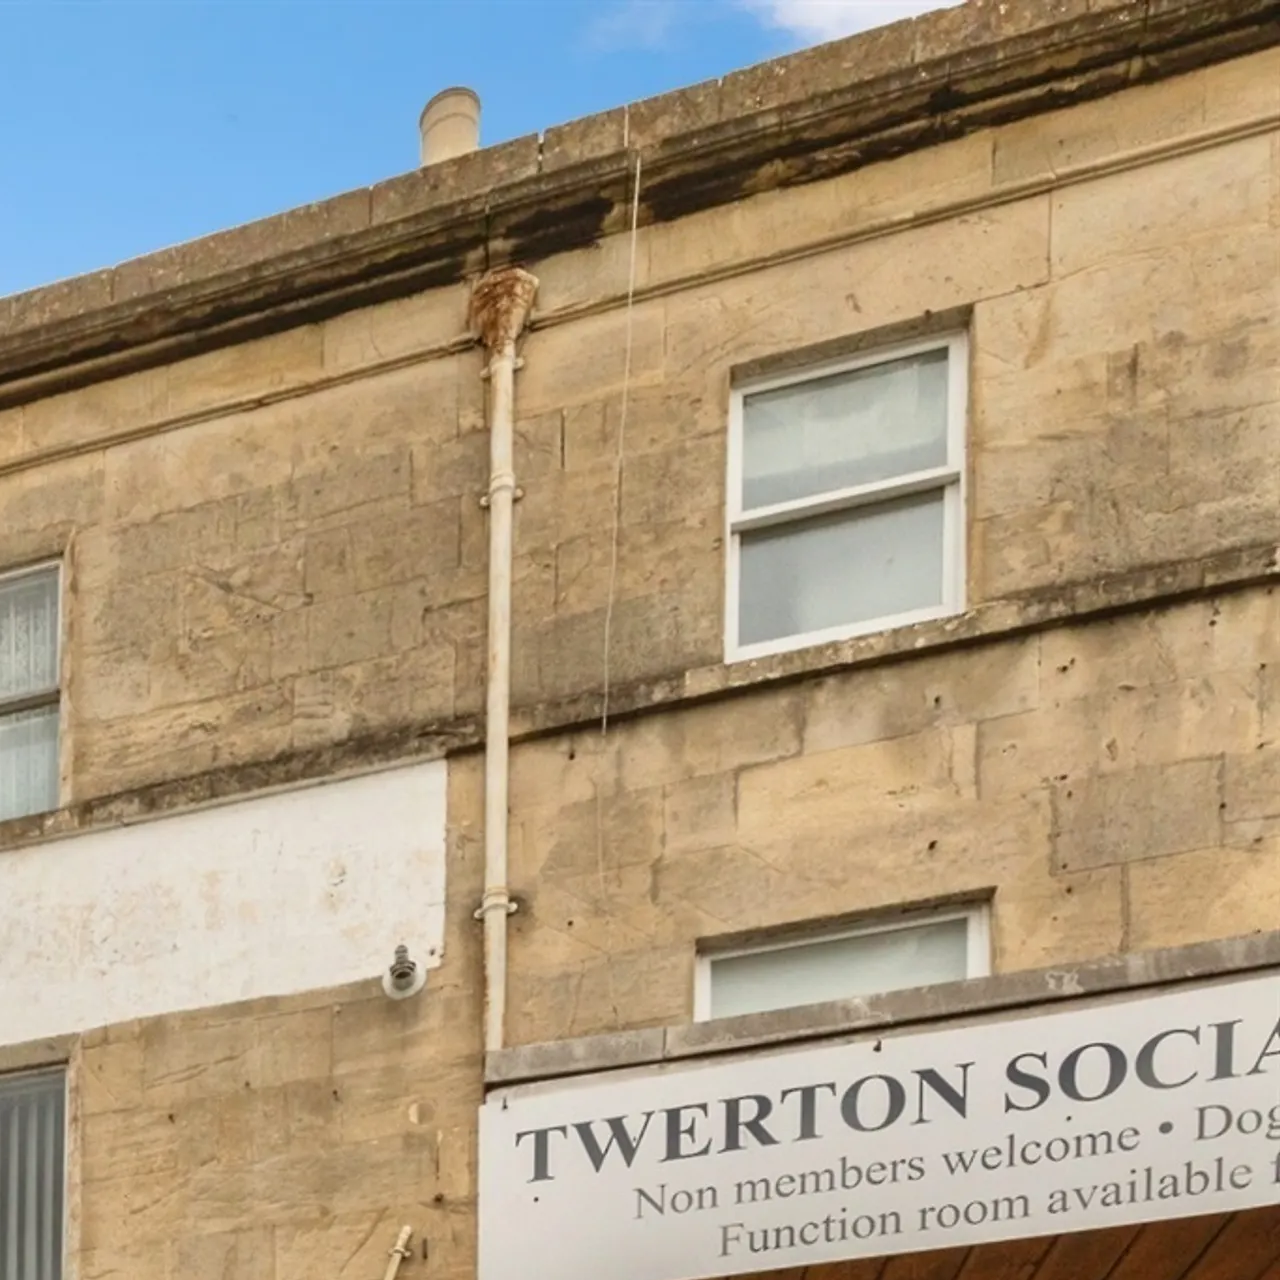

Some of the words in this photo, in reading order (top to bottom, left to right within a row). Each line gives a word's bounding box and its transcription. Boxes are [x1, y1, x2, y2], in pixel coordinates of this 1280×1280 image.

[515, 1061, 975, 1183] TWERTON
[633, 1183, 718, 1219] Non
[734, 1155, 926, 1204] members
[941, 1125, 1140, 1176] welcome
[717, 1206, 902, 1257] Function
[918, 1193, 1031, 1232] room
[1046, 1155, 1253, 1215] available
